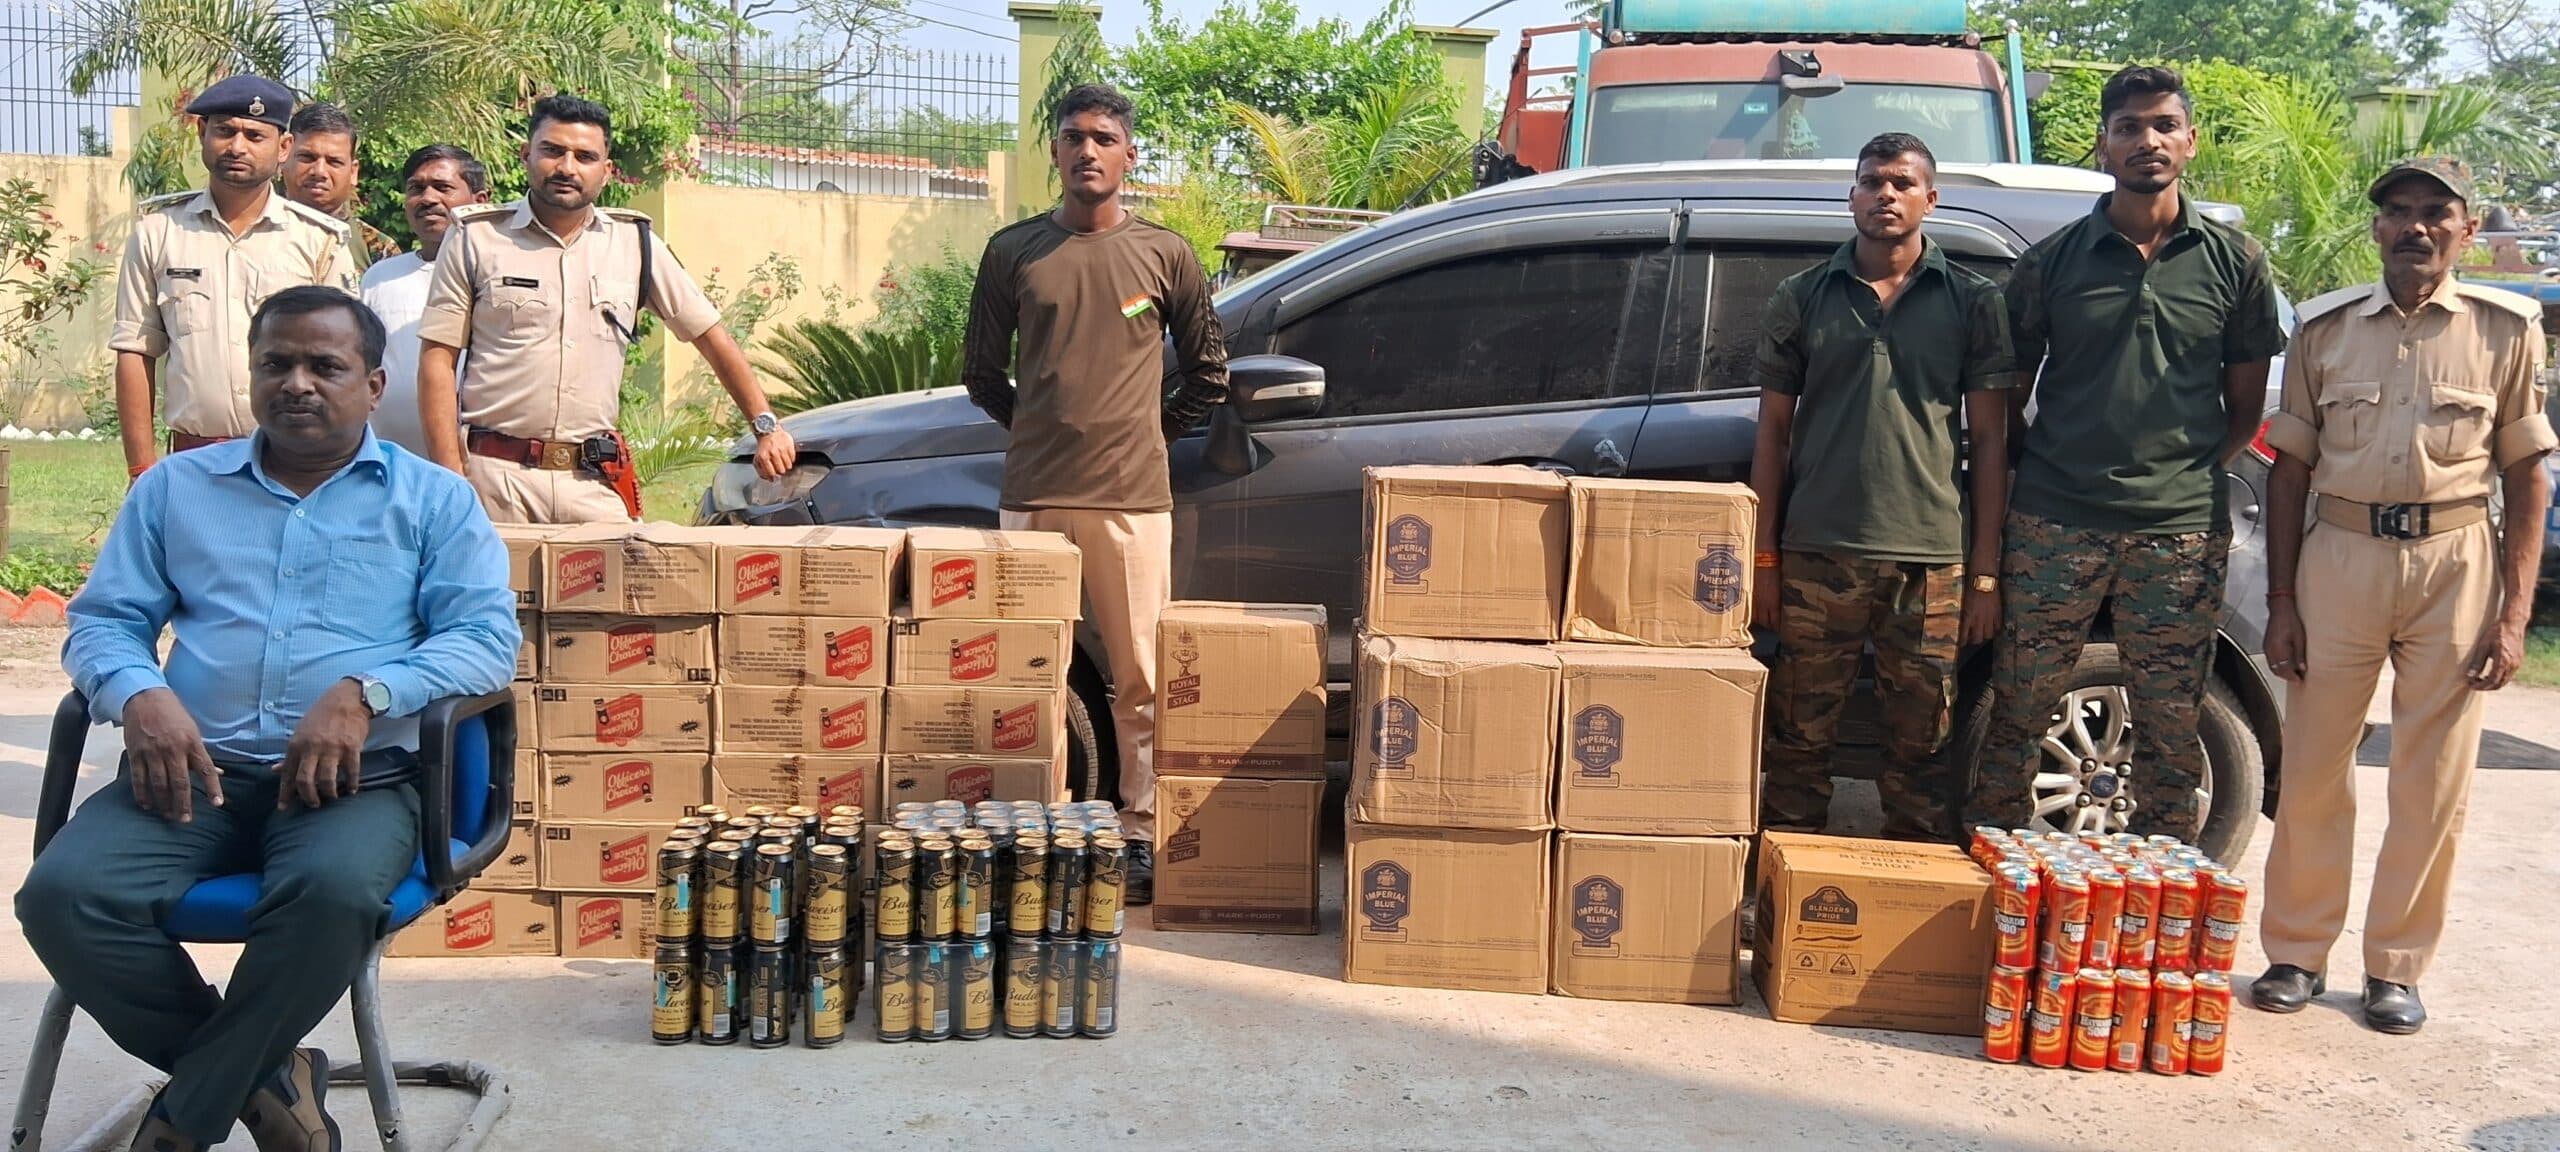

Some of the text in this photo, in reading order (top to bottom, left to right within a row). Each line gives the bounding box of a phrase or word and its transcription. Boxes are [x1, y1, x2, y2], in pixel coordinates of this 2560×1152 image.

[1389, 544, 1428, 556] IMPERIAL
[1397, 553, 1418, 561] BLUE
[1709, 567, 1730, 575] BLUE
[560, 573, 592, 592] Choice
[737, 575, 770, 595] Choice
[1700, 572, 1740, 585] IMPERIAL
[933, 581, 964, 599] Choice
[841, 639, 869, 655] Choice
[963, 640, 996, 658] Choice
[609, 646, 642, 664] Choice
[1171, 678, 1198, 691] ROYAL
[1173, 696, 1195, 706] STAG
[832, 708, 865, 726] Choice
[1005, 711, 1035, 727] Choice
[1374, 727, 1414, 739] IMPERIAL
[1382, 737, 1403, 745] BLUE
[1576, 735, 1619, 748] IMPERIAL
[1586, 745, 1609, 754] BLUE
[607, 785, 641, 802] Choice
[1171, 832, 1197, 845] ROYAL
[613, 843, 647, 860] Choice
[1173, 849, 1195, 861] STAG
[1365, 890, 1406, 903] IMPERIAL
[1374, 900, 1396, 908] BLUE
[1809, 904, 1850, 914] BLENDERS
[457, 908, 492, 926] Choice
[1576, 905, 1619, 919] IMPERIAL
[1586, 915, 1608, 924] BLUE
[580, 919, 613, 938] Choice
